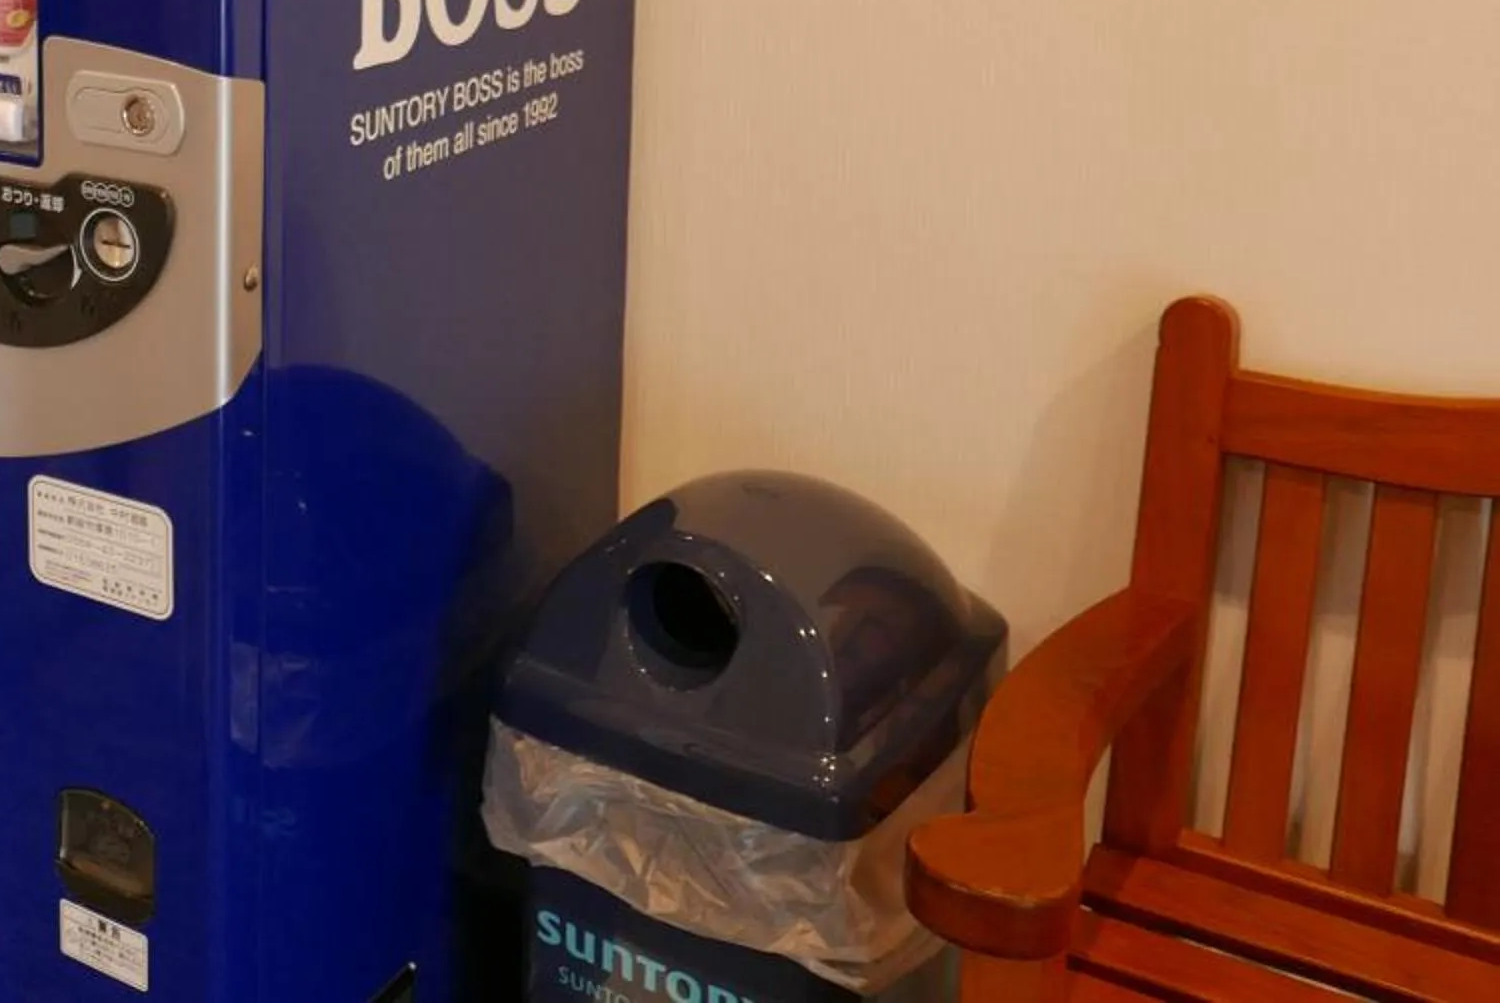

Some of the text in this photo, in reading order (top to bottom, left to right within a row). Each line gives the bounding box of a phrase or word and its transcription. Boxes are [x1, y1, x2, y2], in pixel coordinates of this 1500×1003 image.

[350, 49, 584, 146] SUNTORY BOSS is the boss
[383, 93, 559, 180] of them all since 1992
[537, 910, 753, 1003] SUNTO
